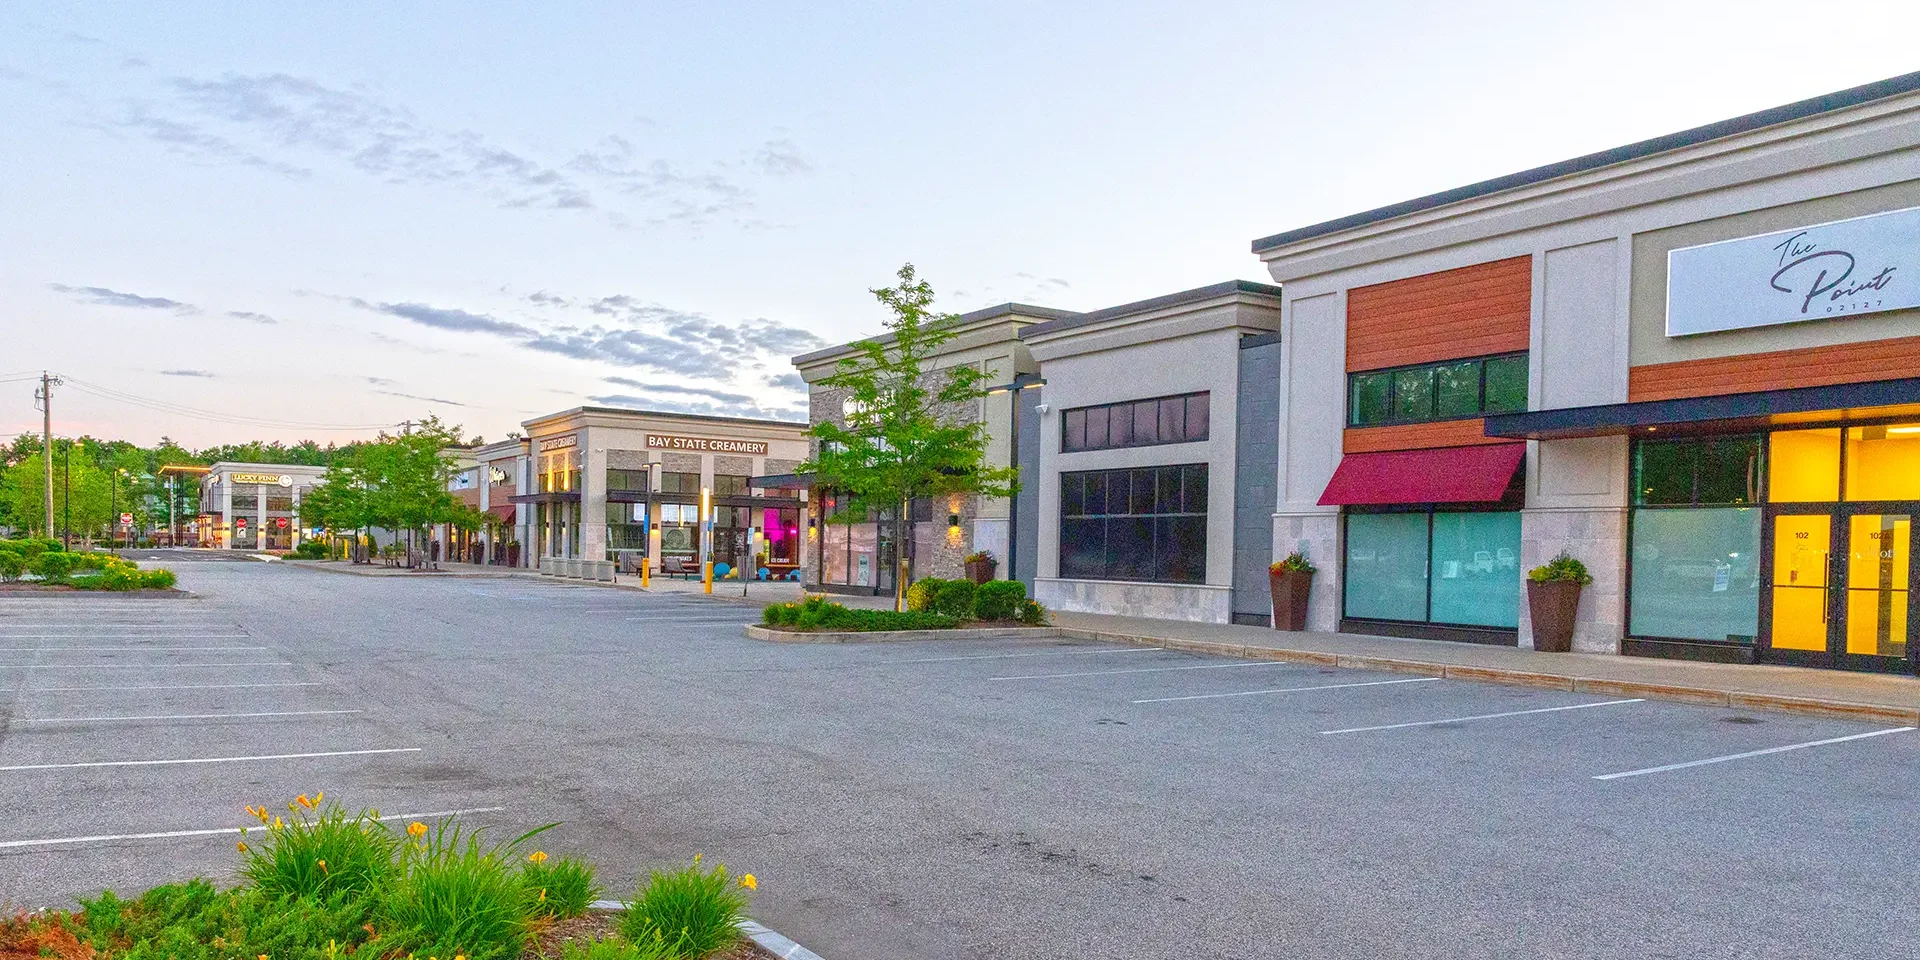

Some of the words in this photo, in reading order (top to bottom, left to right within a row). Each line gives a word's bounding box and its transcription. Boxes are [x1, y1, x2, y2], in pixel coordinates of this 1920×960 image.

[1773, 231, 1817, 267] The
[1769, 250, 1897, 314] Point
[1826, 300, 1882, 313] 02127
[649, 436, 671, 447] BAY
[673, 438, 707, 450] STATE
[710, 440, 766, 453] CREAMERY
